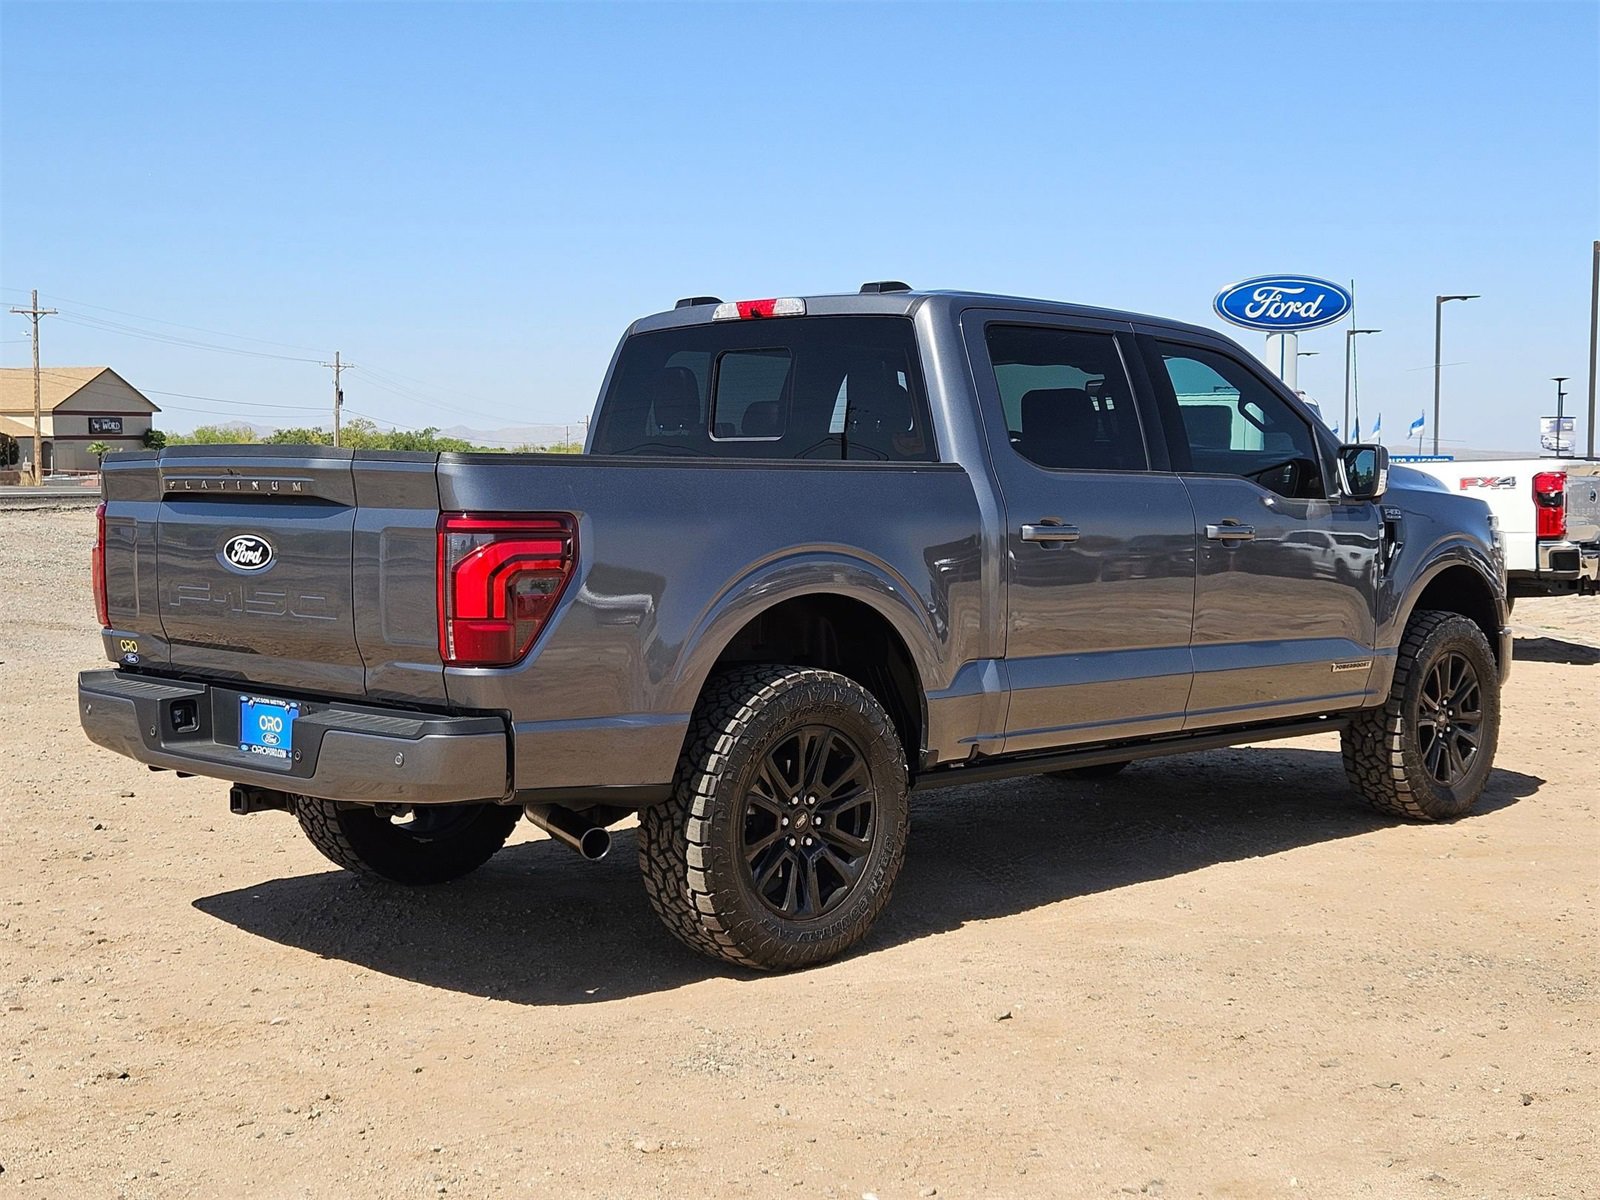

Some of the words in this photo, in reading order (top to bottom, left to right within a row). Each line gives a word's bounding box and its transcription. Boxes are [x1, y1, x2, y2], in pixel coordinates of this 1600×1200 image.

[1244, 286, 1326, 318] Ford
[102, 421, 120, 430] WORD
[168, 480, 303, 492] PLATINUM
[1460, 476, 1516, 490] FX4
[230, 539, 263, 564] Ford
[169, 582, 337, 620] F-150
[120, 639, 138, 653] ORO
[259, 715, 282, 732] ORO
